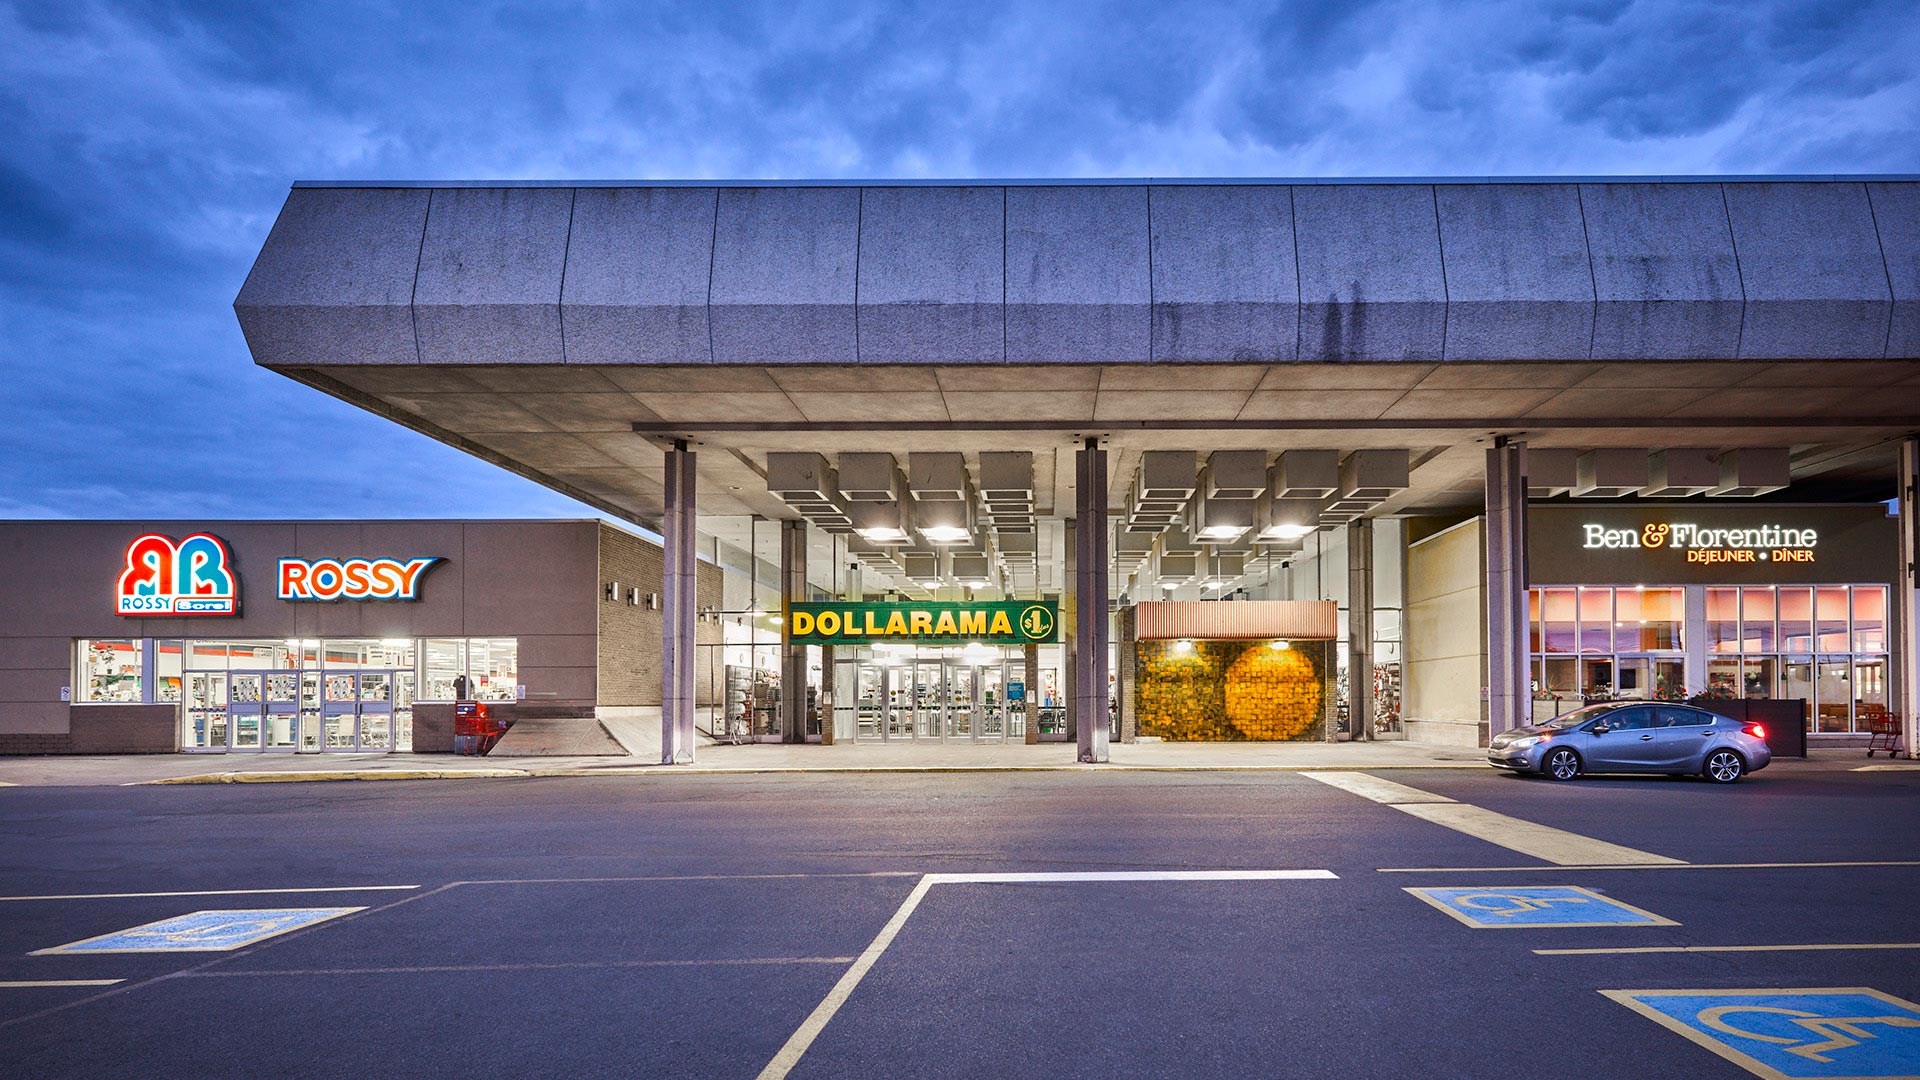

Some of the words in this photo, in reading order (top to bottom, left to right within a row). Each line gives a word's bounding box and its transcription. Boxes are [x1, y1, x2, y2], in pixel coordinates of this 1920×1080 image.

[1583, 524, 1640, 548] Ben
[1642, 523, 1669, 548] &
[1669, 524, 1817, 548] Florentine
[1687, 548, 1755, 565] DÉJEUNER
[1772, 548, 1815, 562] DÎNER
[281, 562, 420, 596] ROSSY
[122, 598, 170, 609] ROSSY
[793, 611, 1013, 635] DOLLARAMA
